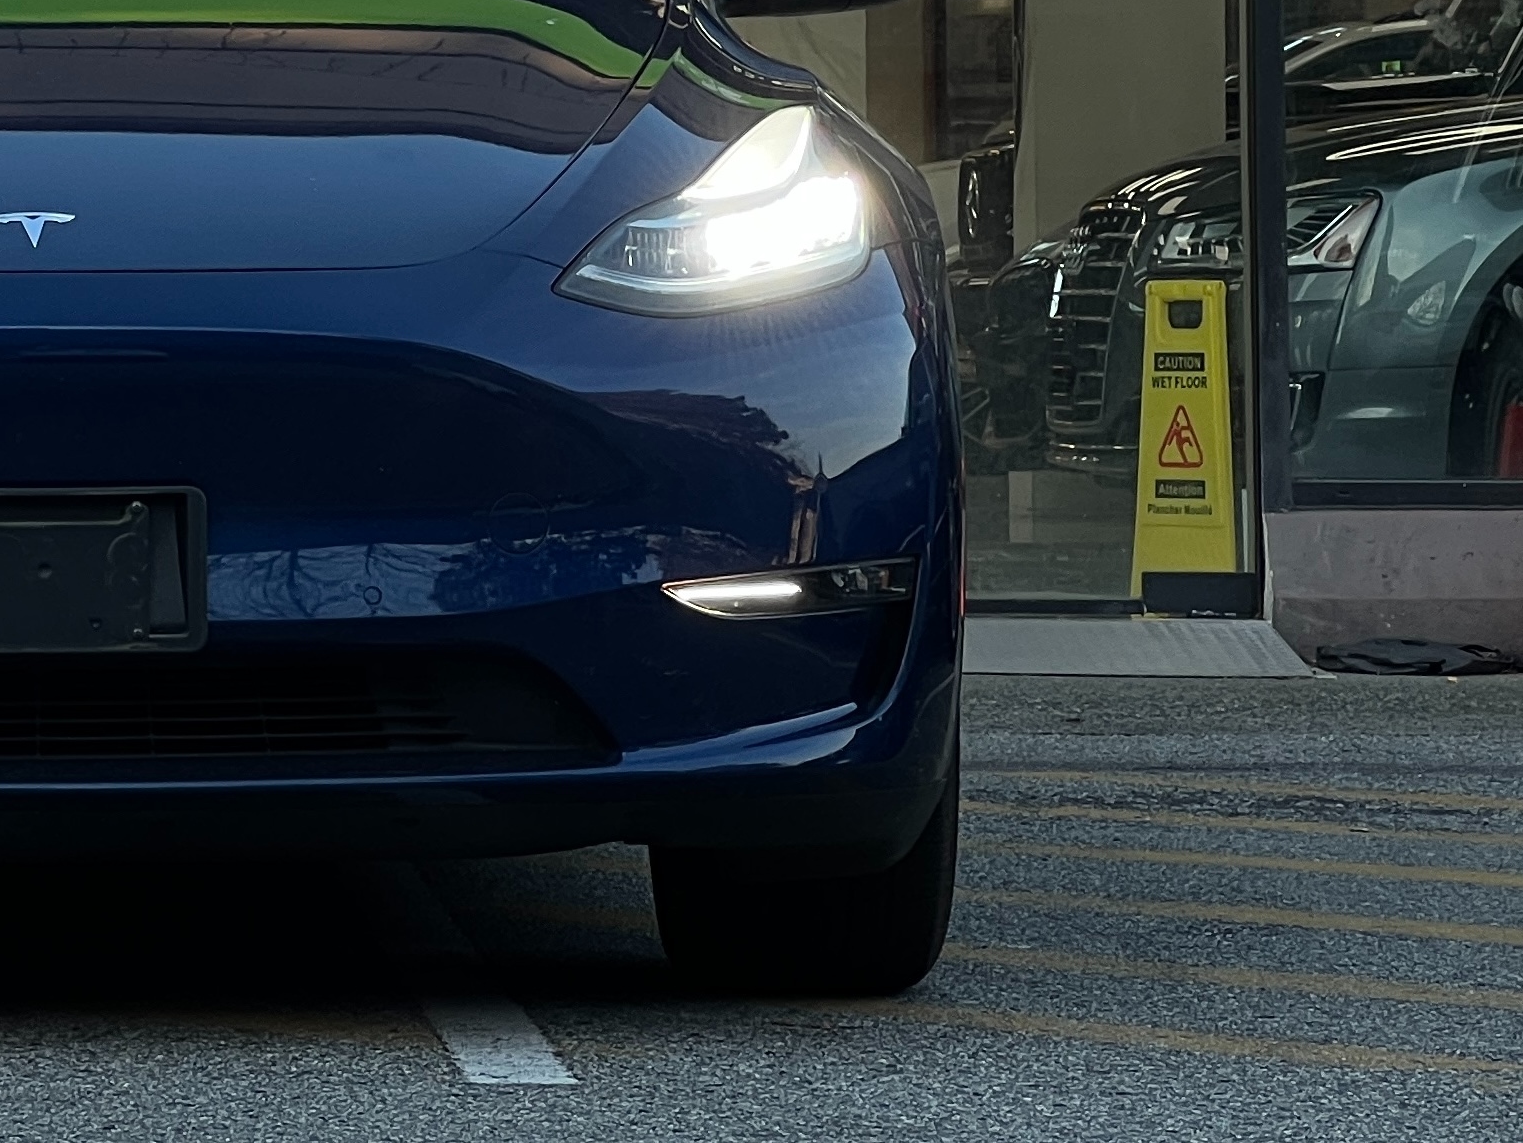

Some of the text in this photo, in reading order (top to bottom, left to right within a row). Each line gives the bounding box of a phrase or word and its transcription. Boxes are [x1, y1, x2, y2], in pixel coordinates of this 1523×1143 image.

[1157, 356, 1201, 369] CAUTION
[1152, 376, 1208, 389] WET FLOOR
[1157, 482, 1204, 497] Attention
